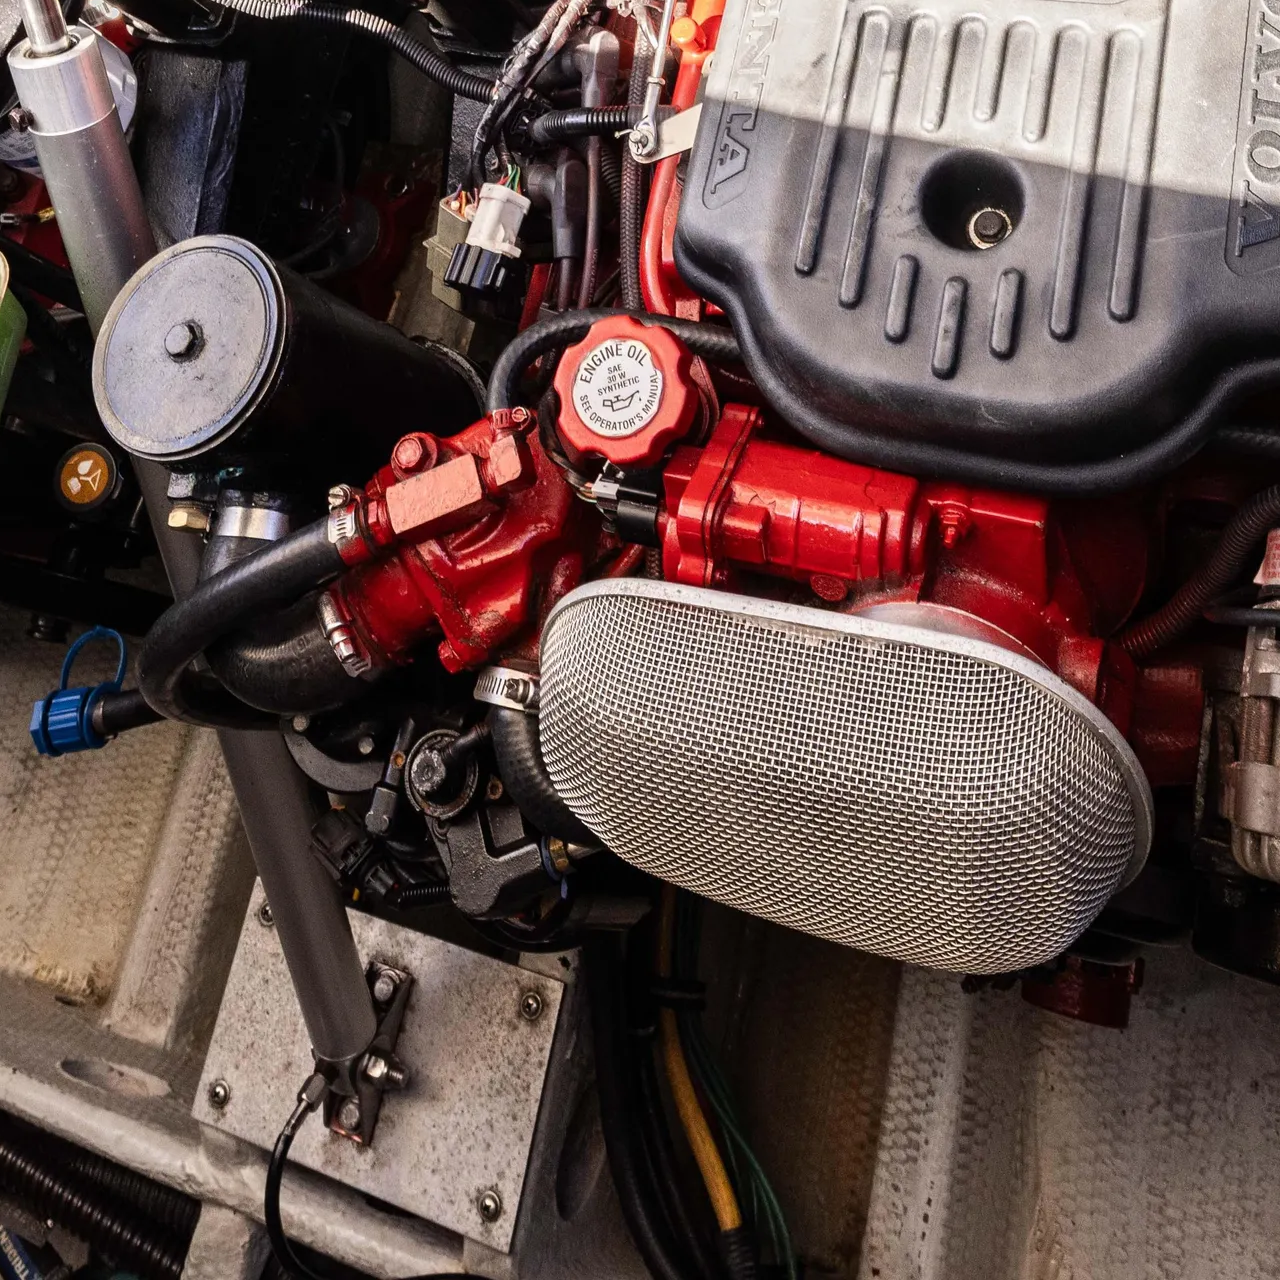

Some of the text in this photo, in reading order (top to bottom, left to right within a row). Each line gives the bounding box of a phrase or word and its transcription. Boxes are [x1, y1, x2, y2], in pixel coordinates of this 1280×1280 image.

[580, 344, 647, 384] ENGINE OIL
[608, 364, 622, 374] SAE
[619, 371, 626, 379] W
[598, 376, 639, 396] SYNTHETIC
[580, 370, 659, 431] SEE OPERATOR'S MANUAL
